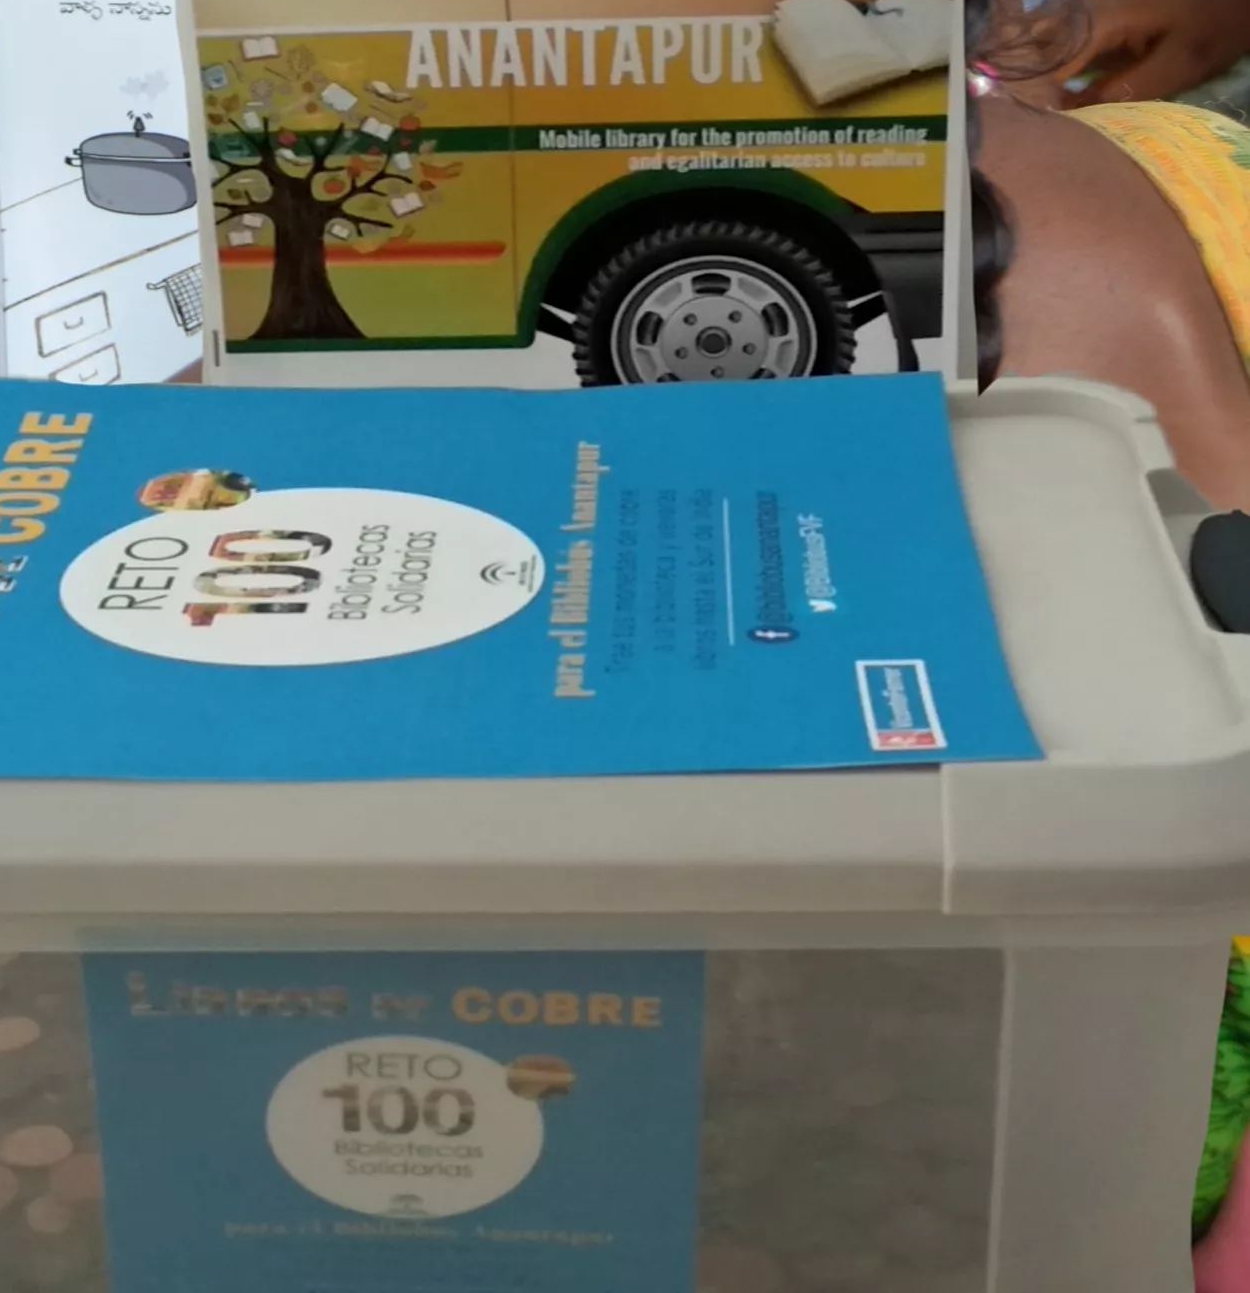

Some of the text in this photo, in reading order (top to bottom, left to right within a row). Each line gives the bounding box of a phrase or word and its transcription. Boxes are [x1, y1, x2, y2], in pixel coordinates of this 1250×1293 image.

[405, 22, 764, 90] ANANTAPUR
[539, 125, 928, 151] Mobile library for the promotion of reading
[628, 153, 661, 171] and
[667, 151, 766, 173] egalitarian
[560, 441, 611, 532] Anantapur
[98, 536, 190, 611] RETO
[181, 529, 333, 627] 100
[327, 523, 390, 621] Bibliotecas
[382, 531, 438, 615] Solidarias
[547, 629, 587, 649] el
[554, 654, 596, 698] para
[452, 987, 663, 1028] COBRE
[347, 1052, 462, 1081] RETO
[321, 1084, 476, 1137] 100
[334, 1139, 484, 1159] Bibliotecas
[344, 1158, 474, 1179] Solidarias
